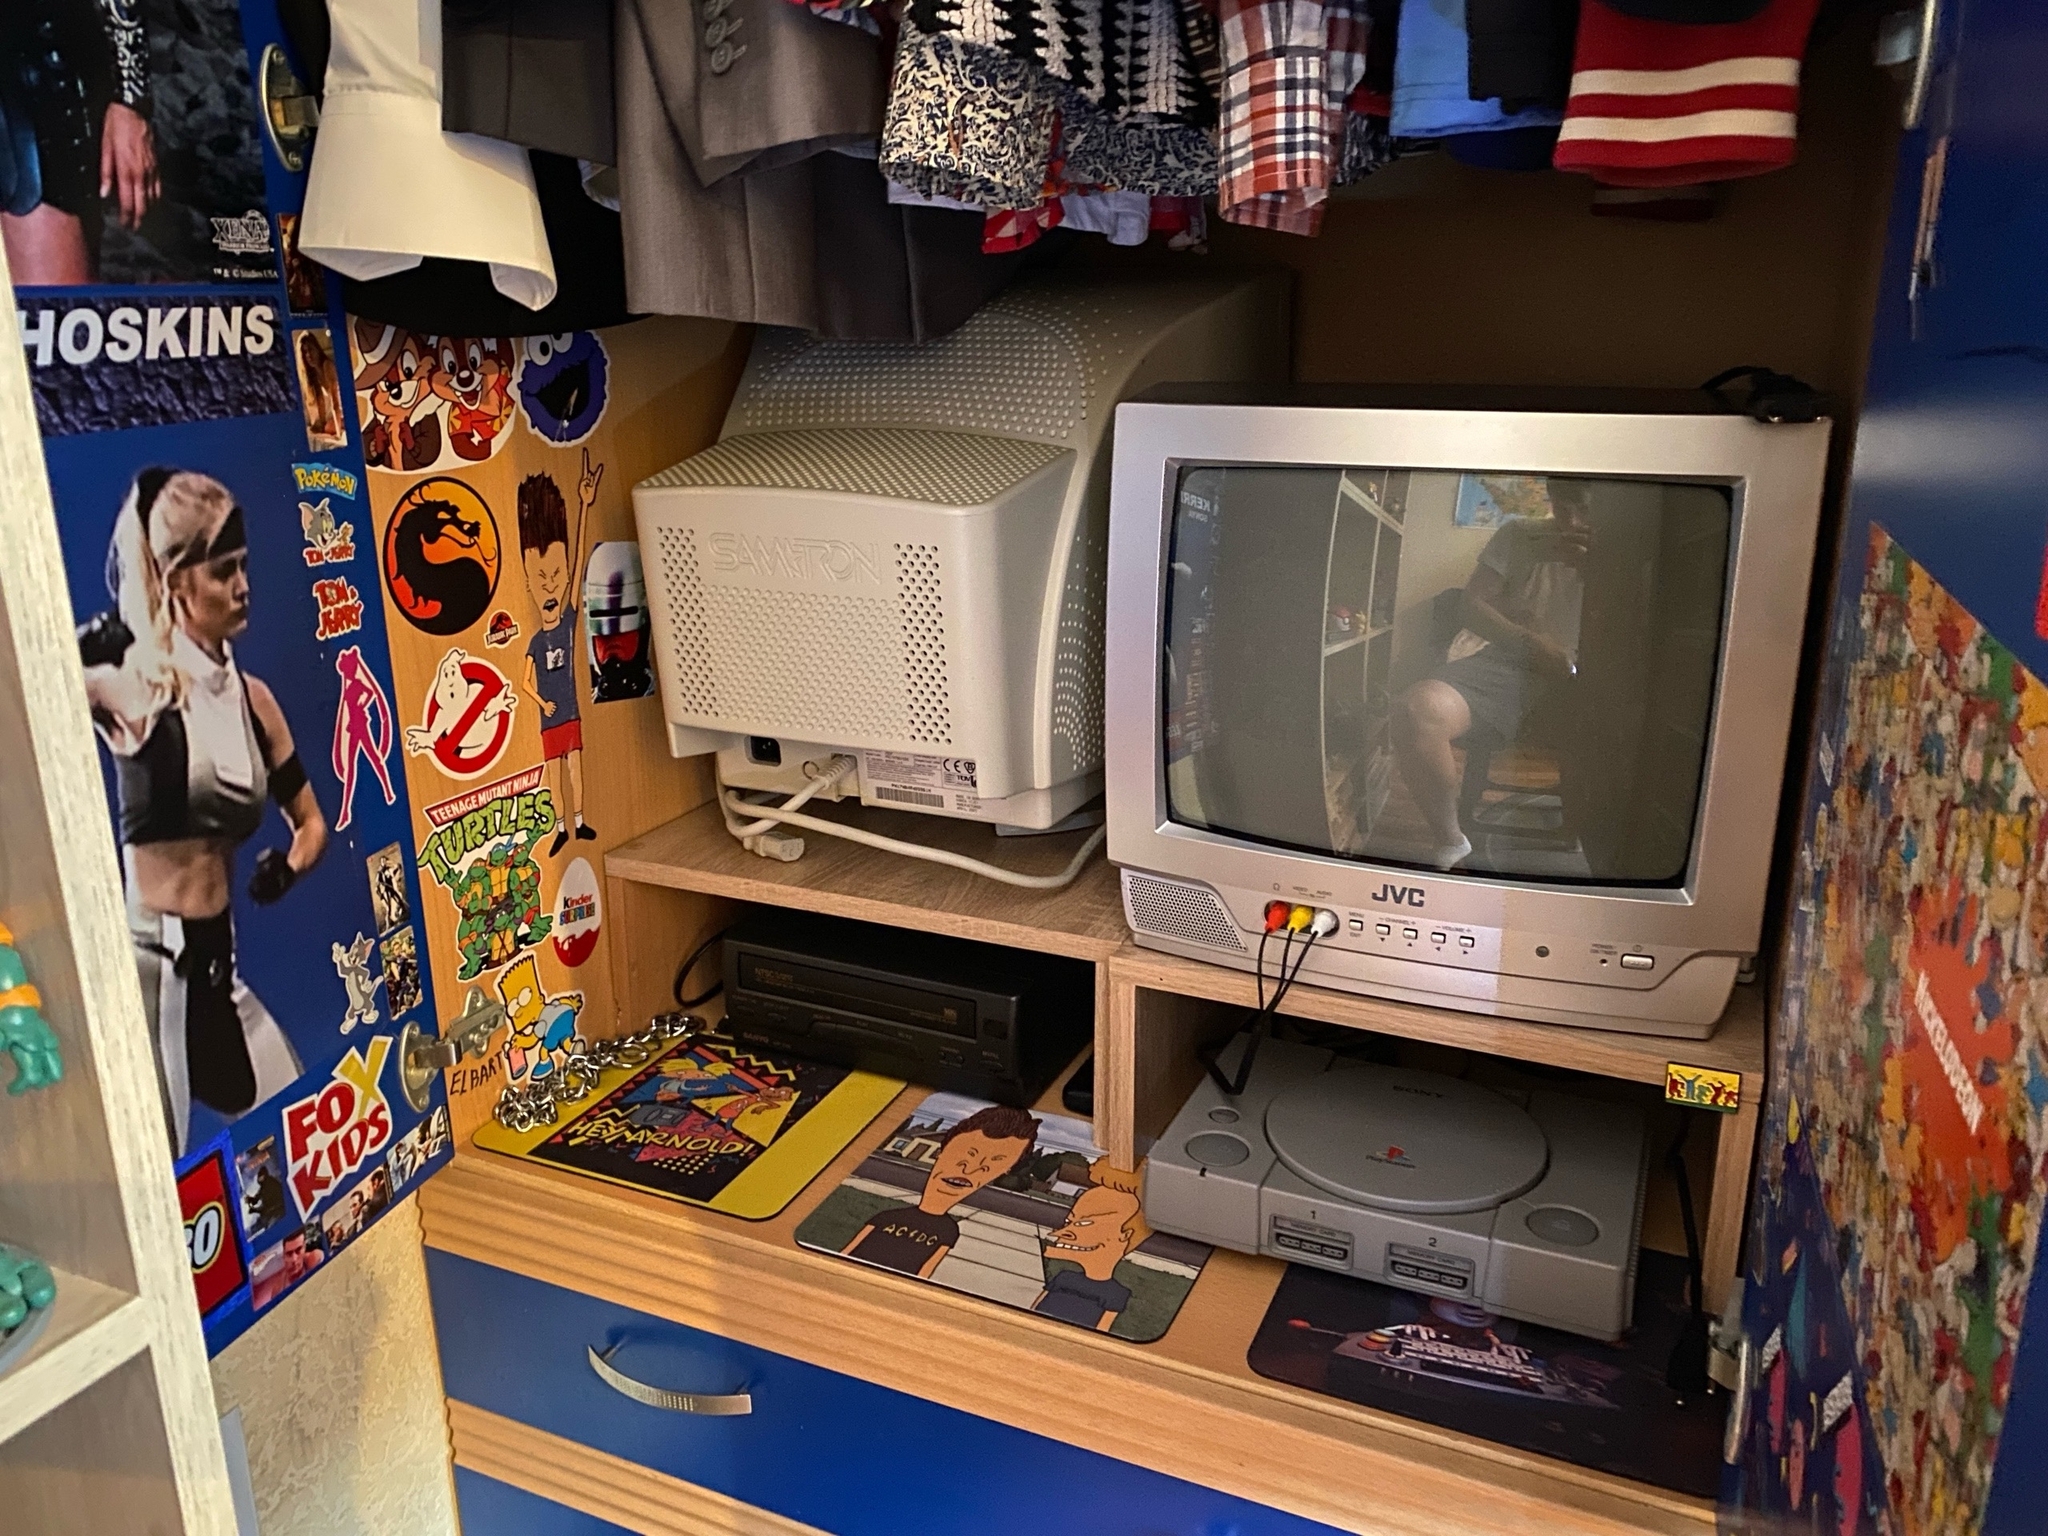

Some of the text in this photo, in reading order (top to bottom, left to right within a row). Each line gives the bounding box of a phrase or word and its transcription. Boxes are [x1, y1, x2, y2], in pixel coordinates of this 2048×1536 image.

[210, 216, 269, 243] XENA
[17, 304, 275, 367] HOSKINS
[708, 531, 881, 585] SAMTRON
[315, 578, 349, 608] TOM
[318, 602, 363, 638] JERRY
[431, 769, 540, 823] TEENAGE MUTANT NINJA
[417, 790, 557, 883] TURTLES
[563, 894, 593, 910] Kinder
[1371, 884, 1425, 908] JVC
[449, 1069, 467, 1096] EL
[1392, 1085, 1444, 1098] SONY
[288, 1037, 393, 1164] FOX
[567, 1120, 755, 1158] HEY ARNOLD!
[292, 1102, 389, 1213] KIDS
[1310, 1210, 1317, 1220] 1
[1428, 1237, 1437, 1248] 2
